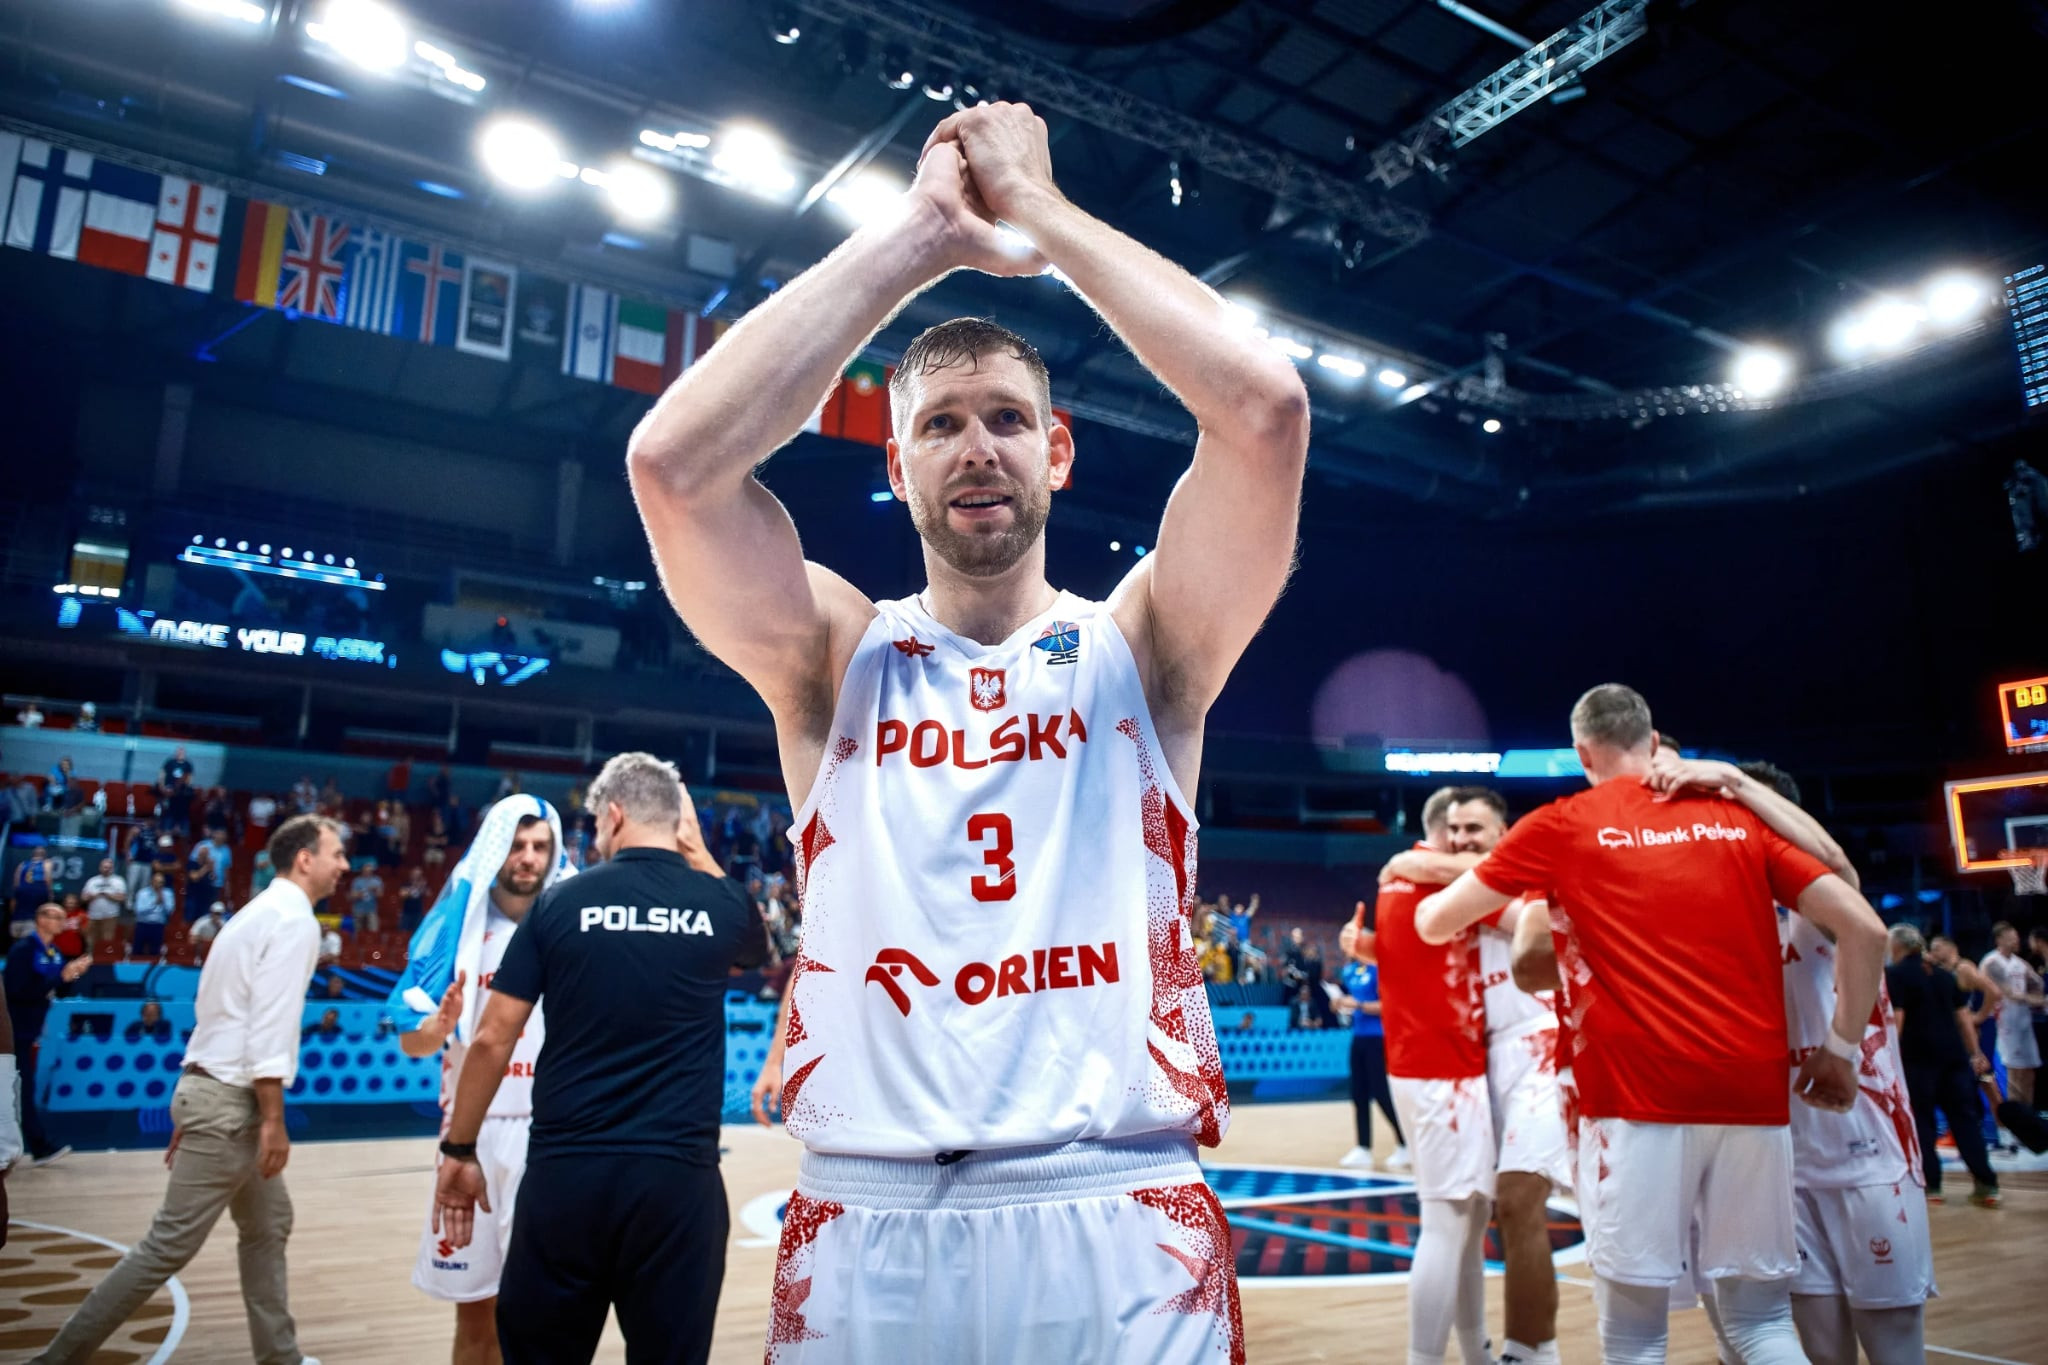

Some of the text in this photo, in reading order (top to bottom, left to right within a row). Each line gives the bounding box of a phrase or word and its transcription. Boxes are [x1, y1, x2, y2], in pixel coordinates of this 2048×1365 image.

[150, 619, 230, 648] MAKE
[237, 627, 306, 655] YOUR
[877, 707, 1088, 770] POLSKA
[1642, 821, 1747, 846] Bank Pekao
[967, 812, 1017, 902] 3
[580, 905, 714, 937] POLSKA
